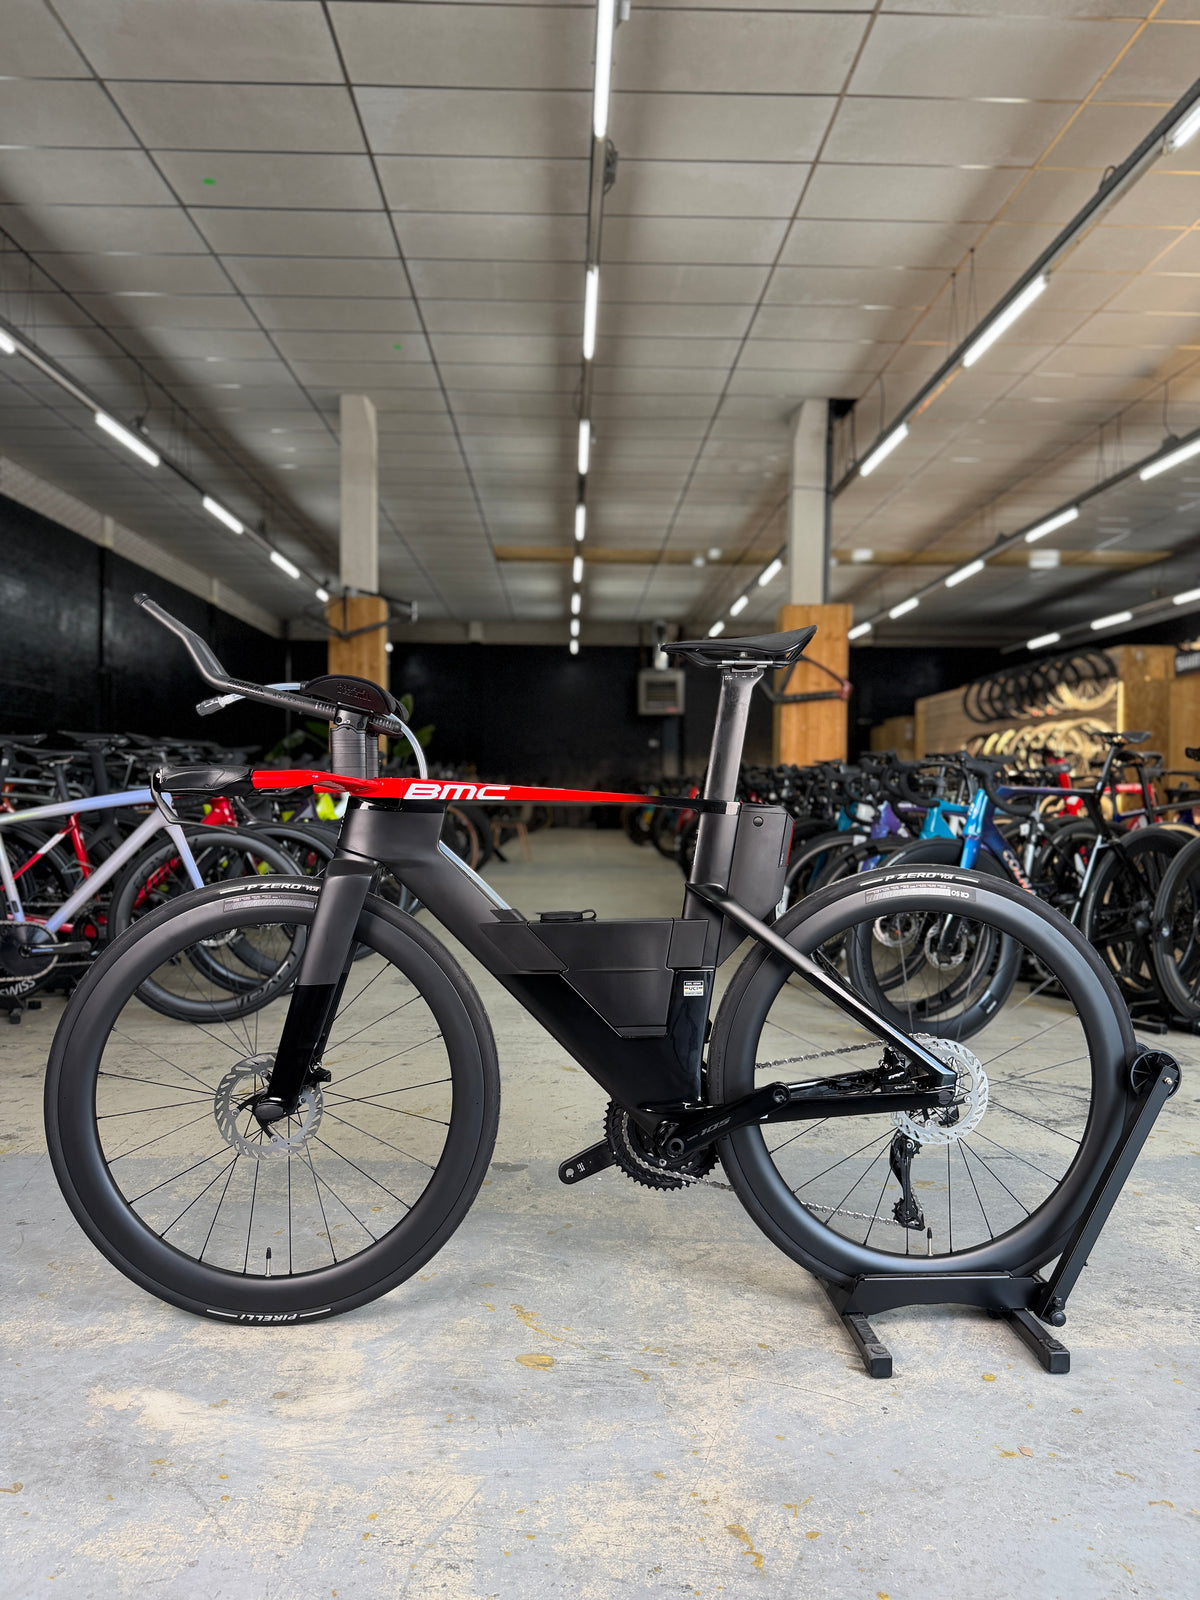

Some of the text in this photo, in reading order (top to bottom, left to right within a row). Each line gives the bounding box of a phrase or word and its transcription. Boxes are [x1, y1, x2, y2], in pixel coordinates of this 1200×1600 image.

[403, 783, 511, 800] BMC
[701, 1116, 731, 1136] 105
[240, 1313, 298, 1322] PIRELLI
